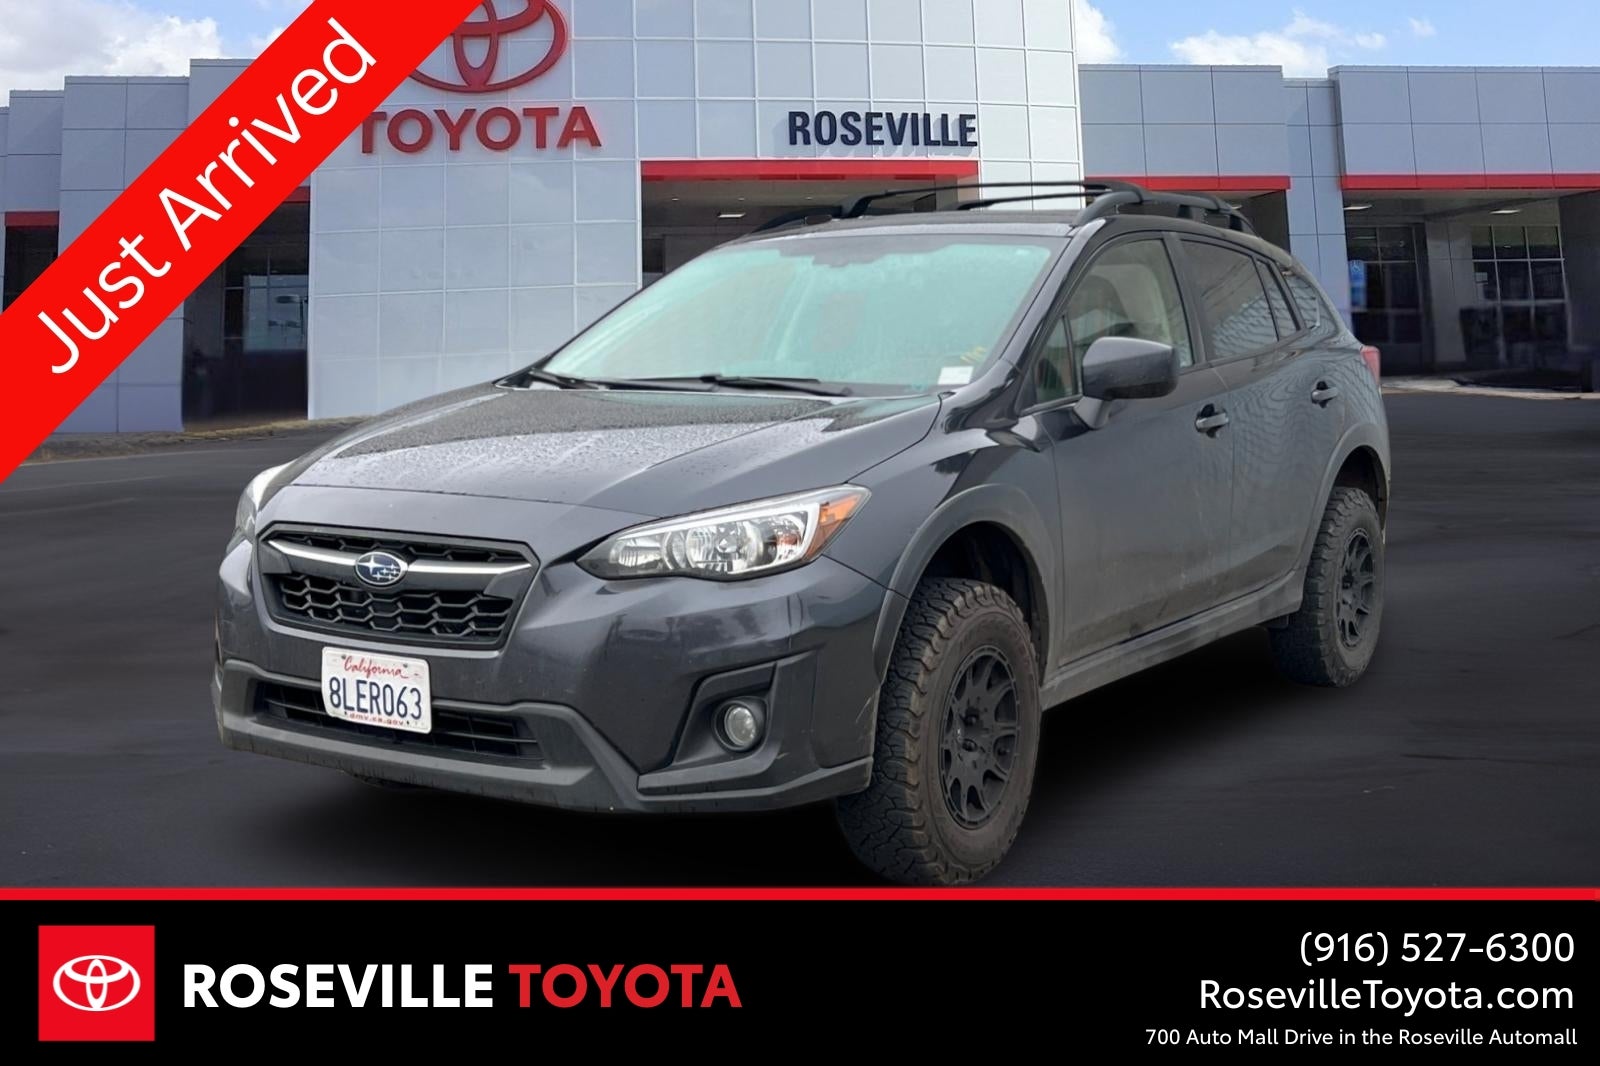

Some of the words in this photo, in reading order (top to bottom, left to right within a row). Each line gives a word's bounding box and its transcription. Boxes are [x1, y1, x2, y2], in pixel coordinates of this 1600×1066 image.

[361, 106, 602, 154] TOYOTA
[788, 110, 978, 147] ROSEVILLE
[344, 655, 409, 679] California
[329, 676, 422, 720] 8LER063
